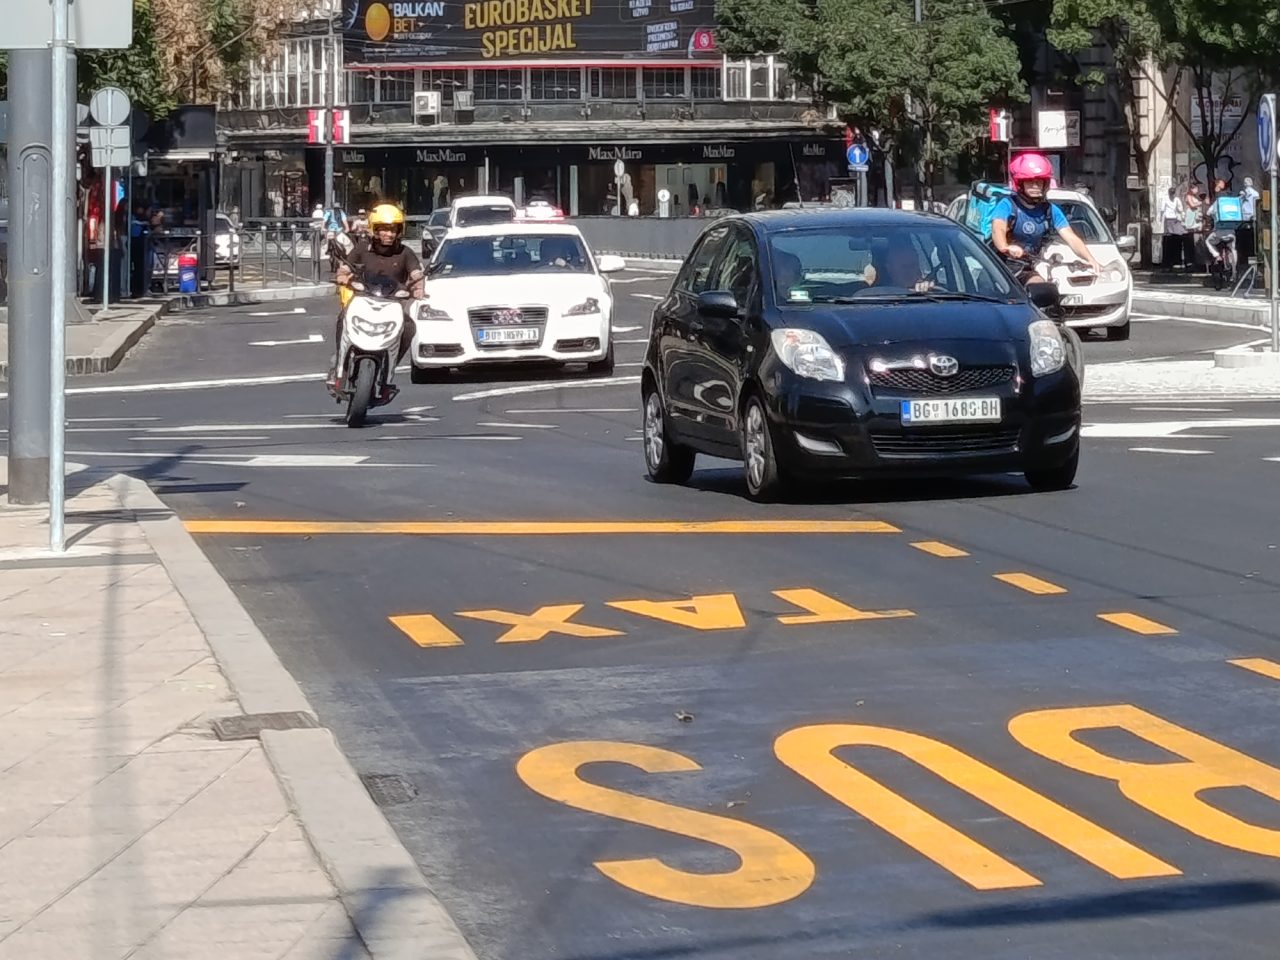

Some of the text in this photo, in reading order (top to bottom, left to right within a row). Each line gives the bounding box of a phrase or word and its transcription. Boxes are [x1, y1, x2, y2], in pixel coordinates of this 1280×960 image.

[393, 2, 444, 17] BALKAN
[393, 18, 416, 32] BET
[481, 22, 577, 58] SPECIJAL
[416, 149, 466, 162] MaxMara
[588, 146, 642, 160] MaxMara
[703, 145, 735, 158] MaxMara
[913, 402, 931, 419] BG
[388, 587, 917, 647] TAXI
